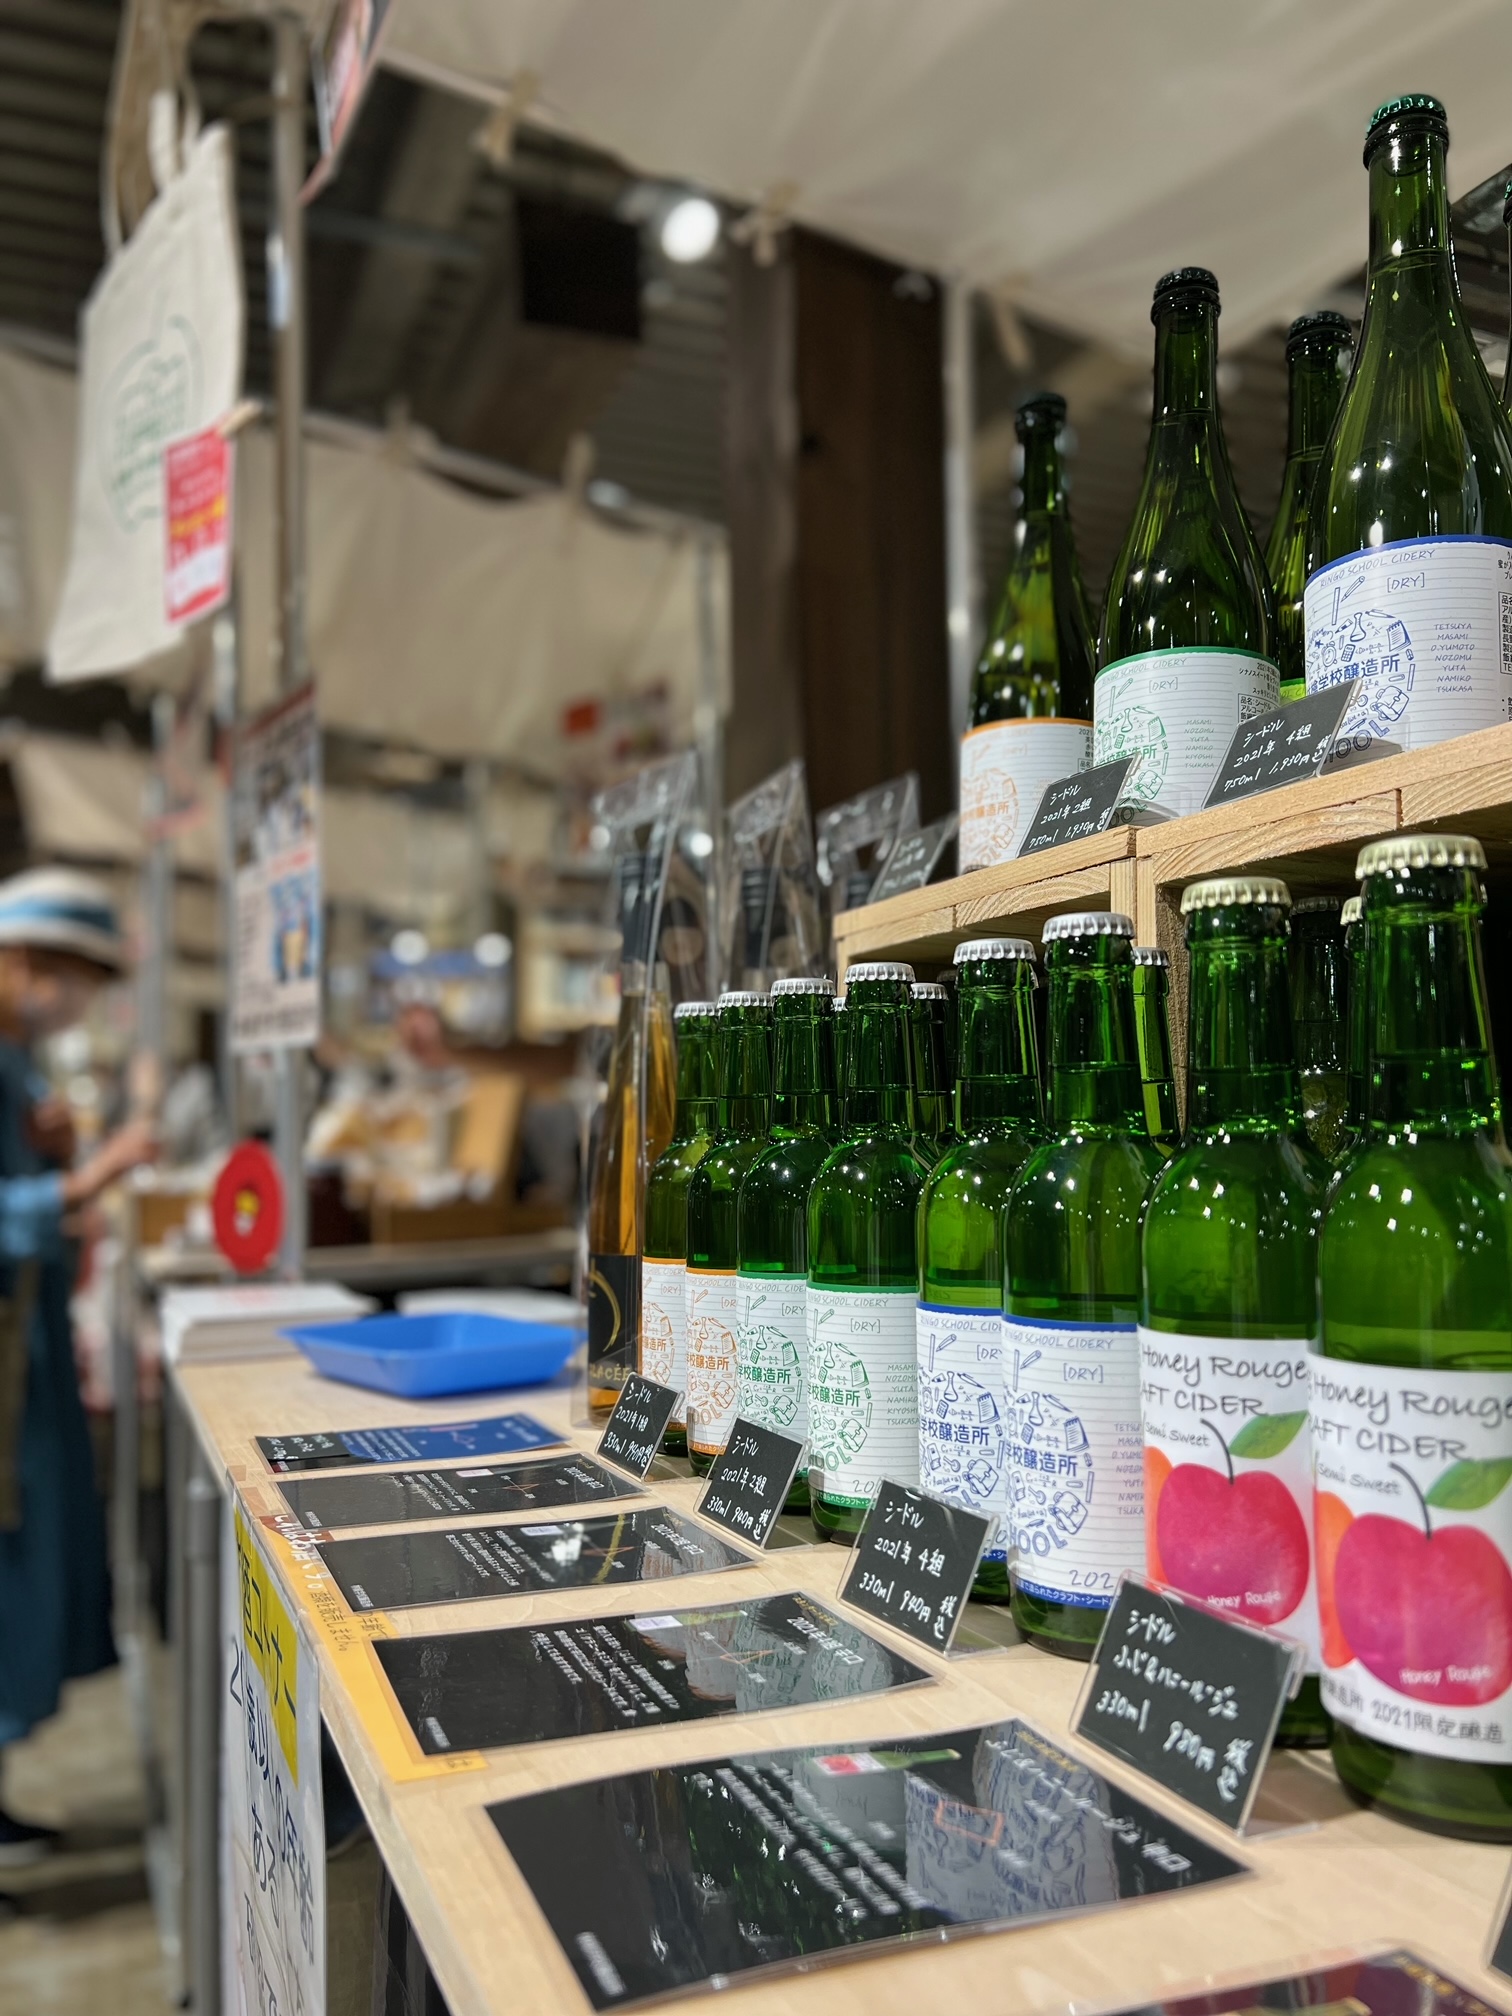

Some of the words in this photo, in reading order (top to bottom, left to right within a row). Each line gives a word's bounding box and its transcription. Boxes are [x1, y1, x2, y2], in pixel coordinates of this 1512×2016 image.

[1348, 556, 1388, 576] SCHOOL
[1391, 549, 1435, 564] CIDERY
[1387, 572, 1425, 593] [DRY]
[1433, 623, 1472, 631] TETSUYA
[1437, 633, 1469, 641] MASAMI
[1121, 663, 1150, 678] SCHOOL
[1153, 658, 1187, 669] CIDERY
[1435, 654, 1472, 662] NOZOMU
[1442, 664, 1467, 672] YUTA
[1149, 677, 1179, 693] [DRY]
[1436, 685, 1473, 693] TSUKASA
[1437, 675, 1472, 683] NAMIKO
[1243, 719, 1285, 748] シードル
[1234, 740, 1275, 767] 2021年
[1224, 768, 1261, 792] 750ml
[1050, 785, 1081, 805] シードル
[1029, 829, 1059, 848] 750ml
[755, 1284, 781, 1292] SCHOOL
[822, 1296, 850, 1306] SCHOOL
[854, 1299, 889, 1307] CIDERY
[850, 1318, 881, 1333] [DRY]
[941, 1319, 976, 1330] SCHOOL
[1026, 1333, 1063, 1346] SCHOOL
[1067, 1338, 1113, 1349] CIDERY
[1063, 1363, 1103, 1383] [DRY]
[1142, 1344, 1200, 1387] Honey
[1209, 1356, 1307, 1388] Rouge
[625, 1382, 652, 1405] シードル
[1175, 1390, 1268, 1416] CIDER
[1314, 1372, 1388, 1425] Honey
[732, 1435, 759, 1456] シードル
[1357, 1428, 1474, 1461] CIDER
[707, 1495, 732, 1518] 330ml
[731, 1506, 754, 1529] 940円
[884, 1501, 925, 1529] シードル
[859, 1572, 895, 1603] 330ml
[900, 1590, 931, 1623] 940円
[1126, 1609, 1176, 1645] シードル
[1096, 1690, 1150, 1733] 330ml
